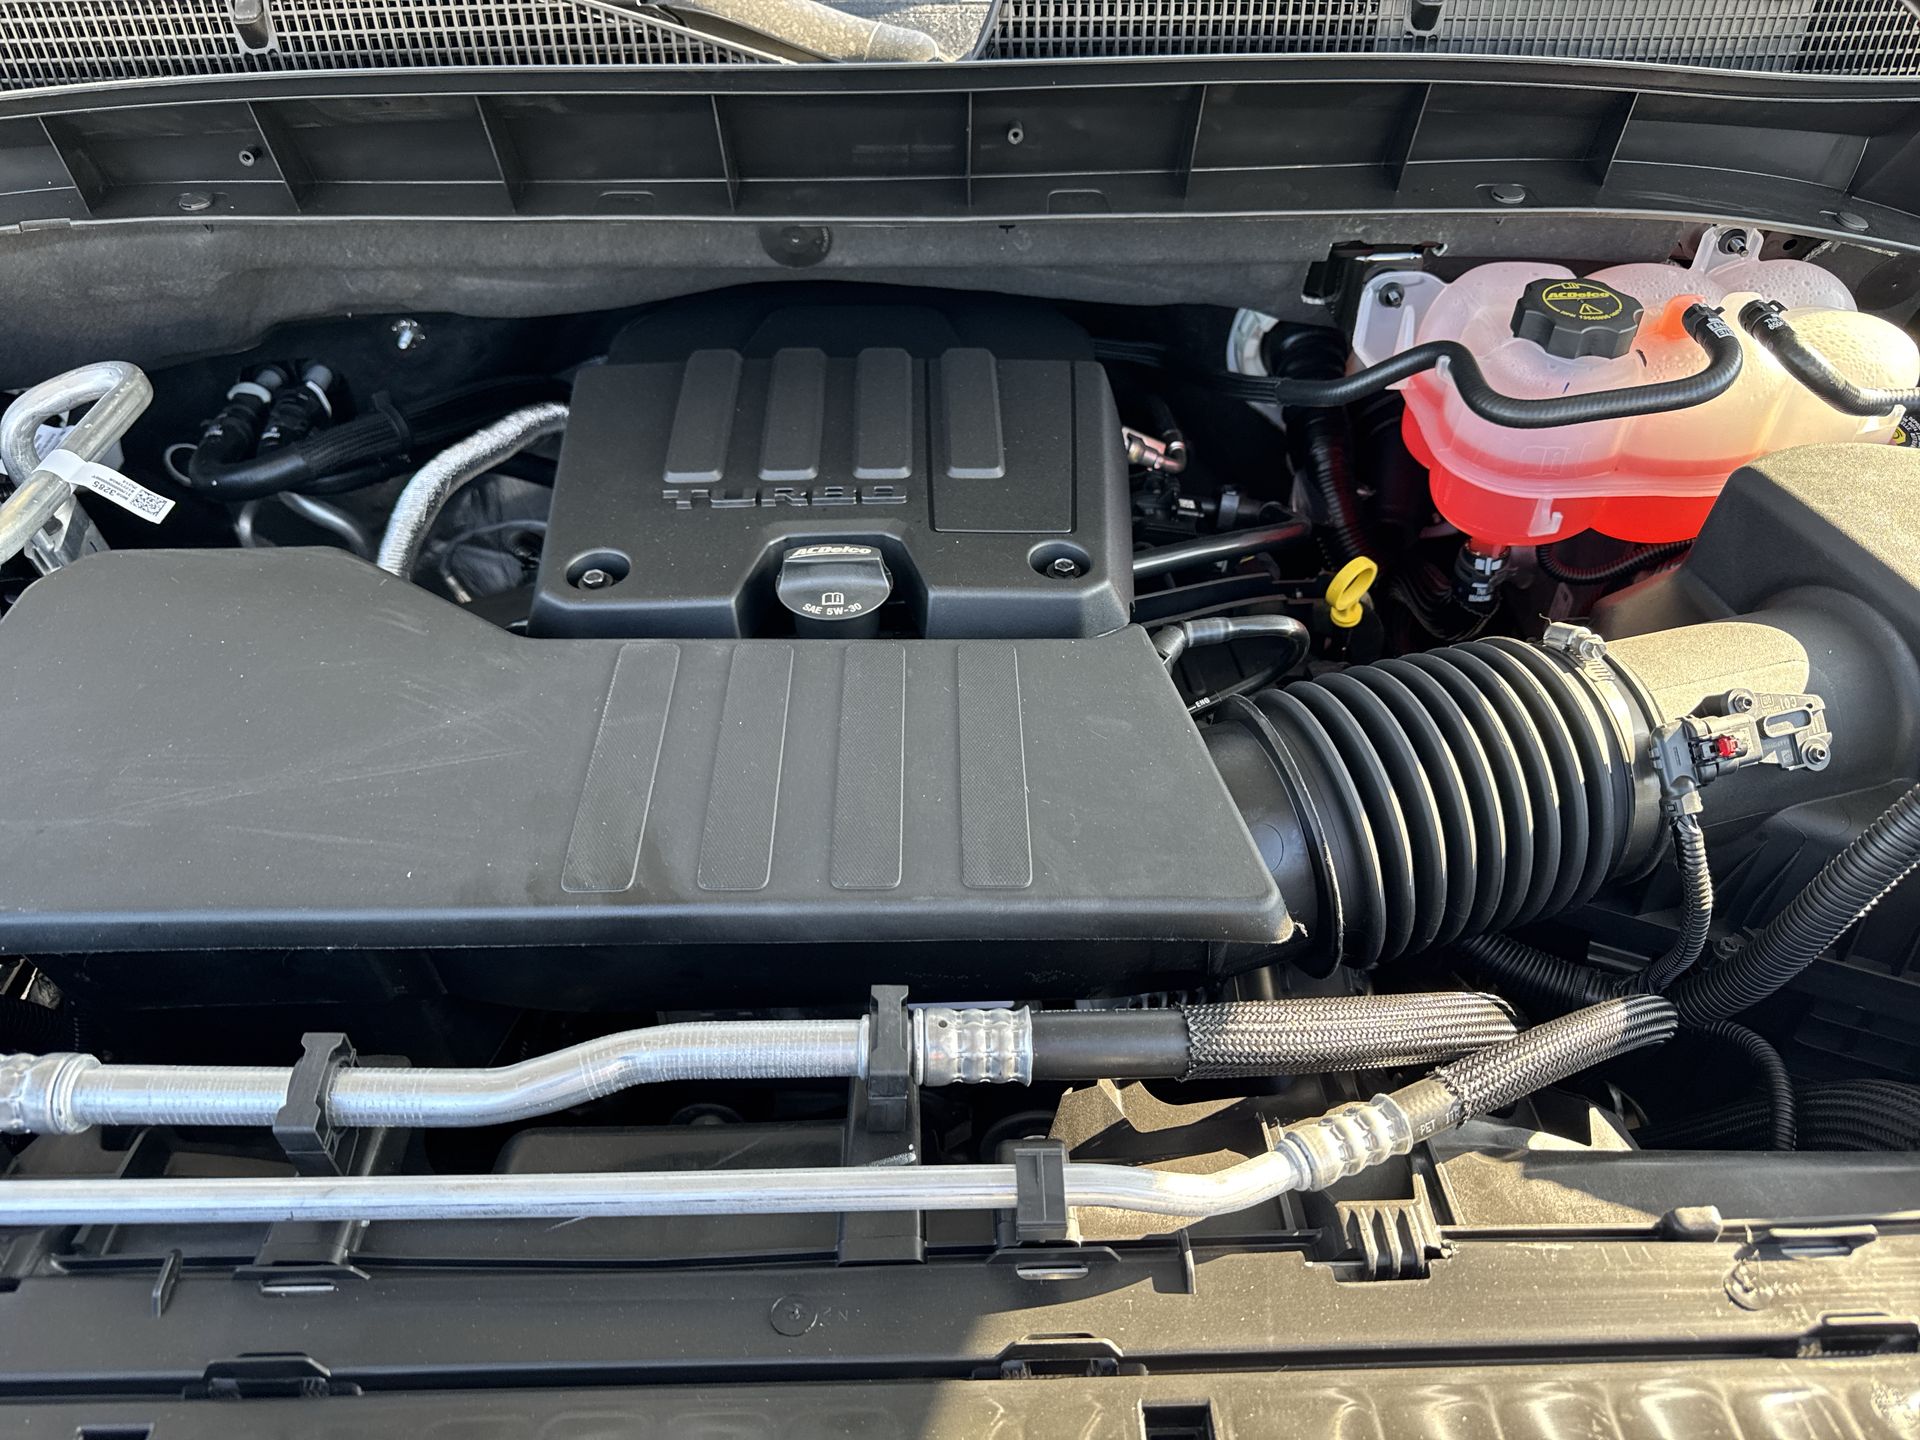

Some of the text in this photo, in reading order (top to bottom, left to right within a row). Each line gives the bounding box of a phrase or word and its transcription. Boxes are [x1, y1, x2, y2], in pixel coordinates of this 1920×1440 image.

[789, 545, 872, 559] ACDelco
[802, 602, 862, 616] SAE 5W-30
[1420, 1119, 1435, 1135] PET
